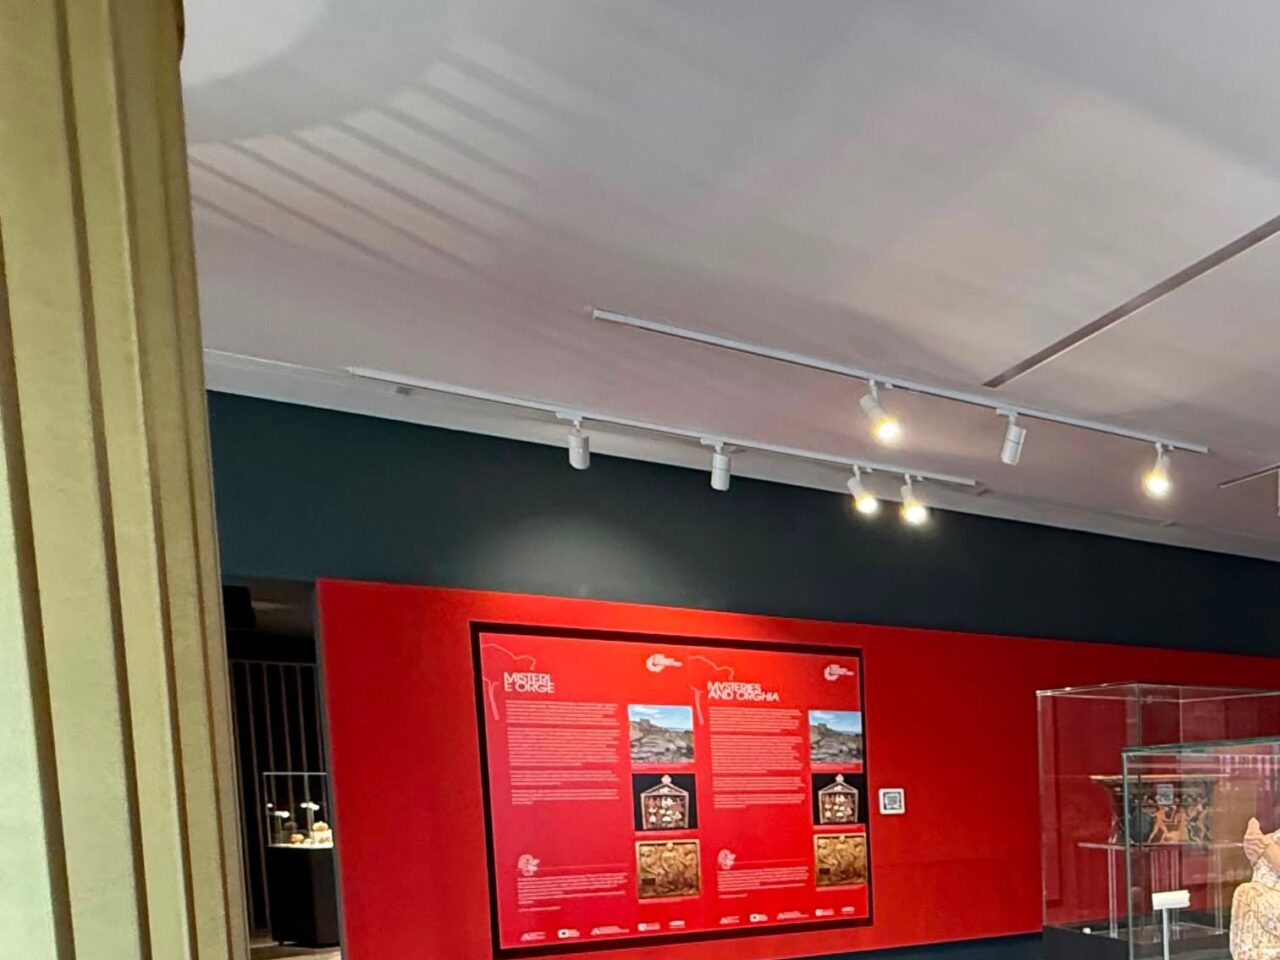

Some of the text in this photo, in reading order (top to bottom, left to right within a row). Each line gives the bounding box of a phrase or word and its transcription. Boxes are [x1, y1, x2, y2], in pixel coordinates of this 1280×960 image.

[504, 672, 550, 683] MISTERI
[505, 682, 555, 693] E ORGE
[707, 681, 761, 693] MYSTERIES
[708, 690, 779, 702] AND ORGHIA
